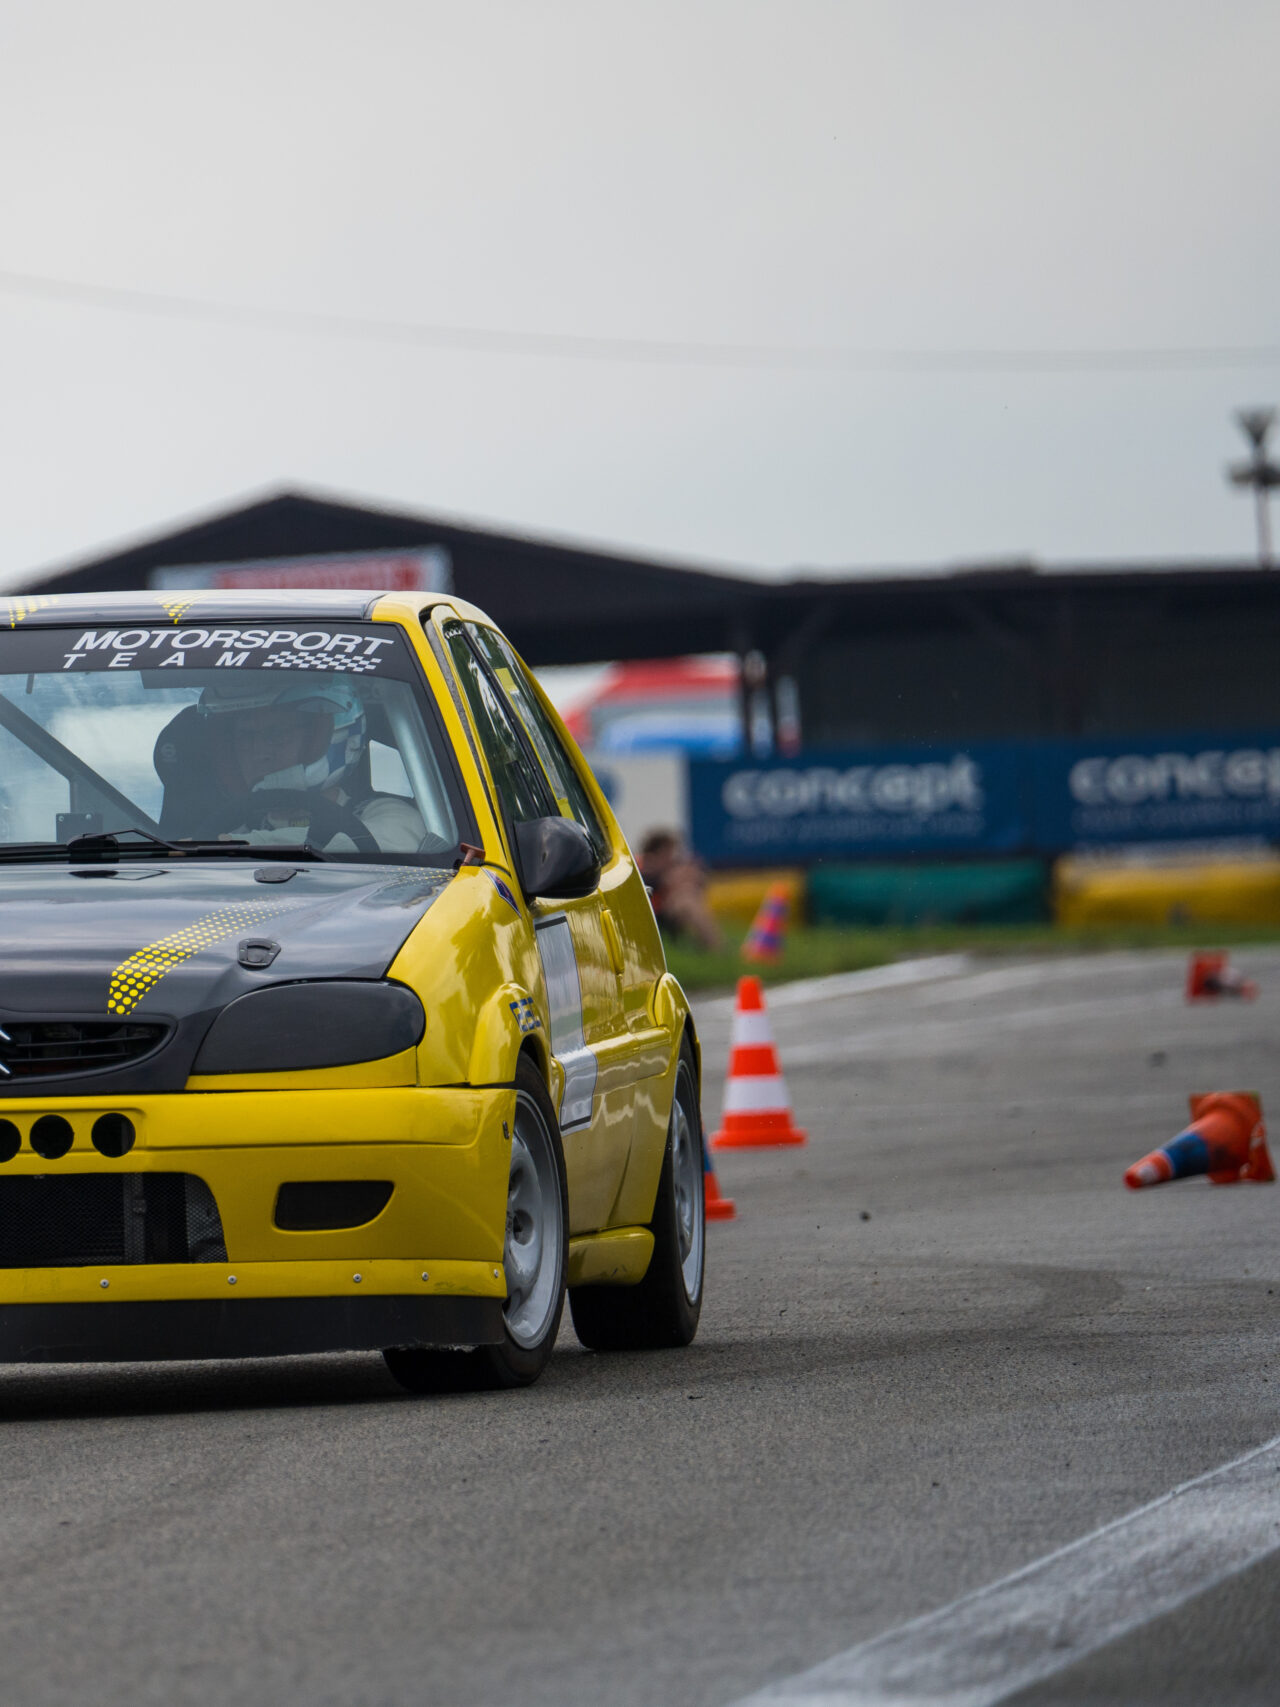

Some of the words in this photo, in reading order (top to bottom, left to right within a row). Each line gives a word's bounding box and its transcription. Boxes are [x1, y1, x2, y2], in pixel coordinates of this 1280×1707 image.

[72, 629, 394, 655] MOTORSPORT
[62, 651, 250, 669] TEAM
[724, 756, 980, 817] concept
